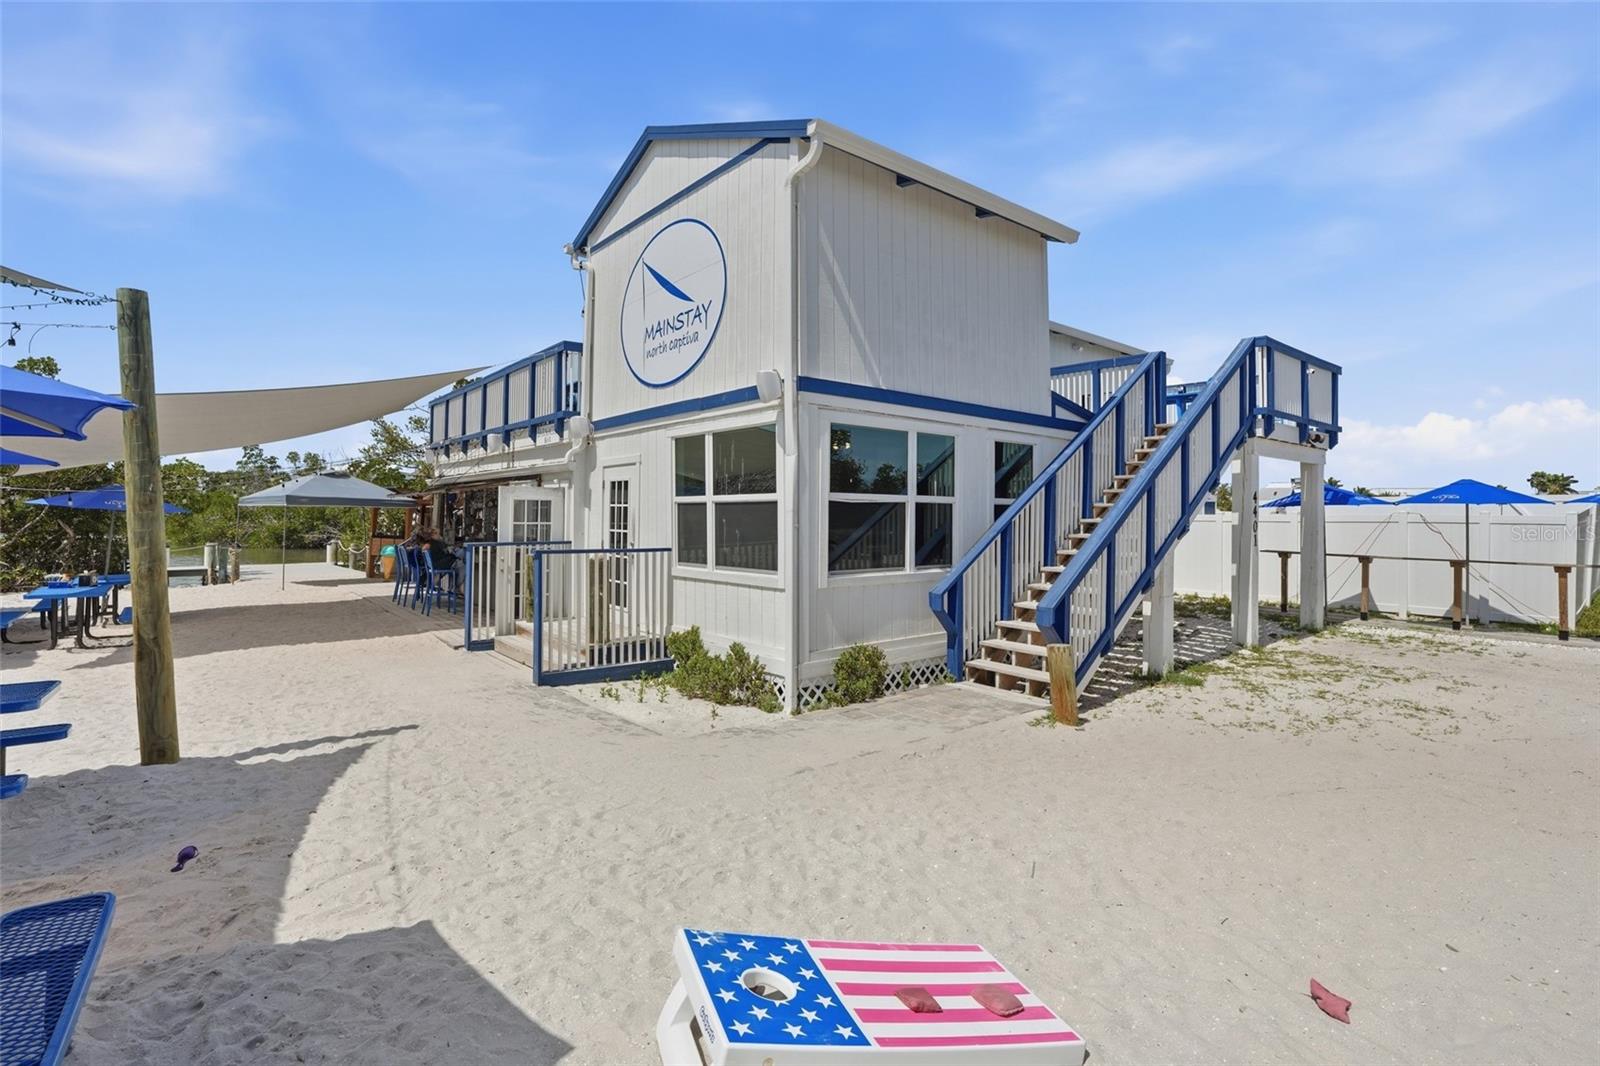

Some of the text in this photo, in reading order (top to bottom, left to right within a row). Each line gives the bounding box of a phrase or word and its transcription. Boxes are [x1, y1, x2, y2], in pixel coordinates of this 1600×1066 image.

[644, 299, 712, 344] MAINSTAY
[646, 331, 699, 359] north captiva
